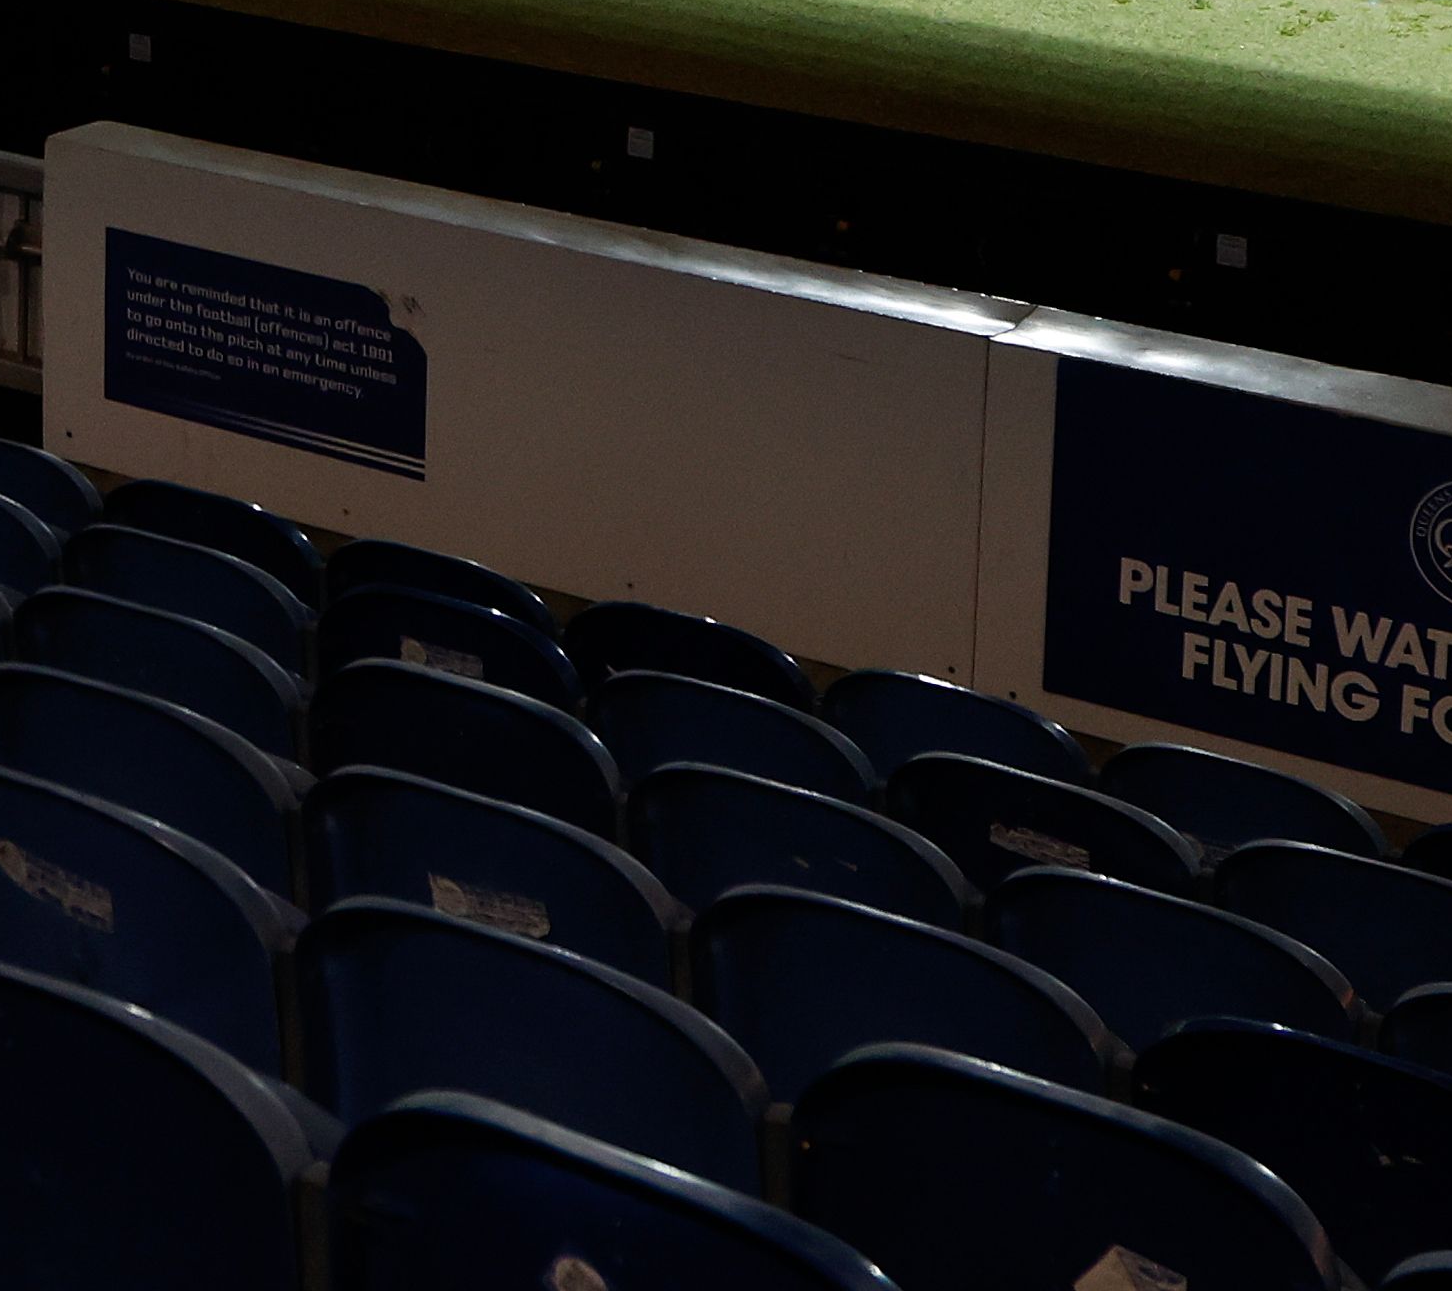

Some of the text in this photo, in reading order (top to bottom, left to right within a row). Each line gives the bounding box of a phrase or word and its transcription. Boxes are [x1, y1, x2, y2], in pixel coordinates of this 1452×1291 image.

[127, 266, 392, 342] You are reminded that it is an offence
[127, 290, 166, 308] under
[170, 298, 193, 315] the
[197, 302, 251, 329] football
[333, 337, 356, 355] act
[127, 308, 397, 385] to go onto the pitch at any time unless
[127, 328, 184, 353] directed
[188, 342, 203, 358] to
[207, 346, 224, 363] do
[228, 354, 244, 367] so
[247, 356, 259, 372] in
[263, 361, 279, 376] an
[283, 369, 364, 401] emergency.
[1117, 557, 1313, 648] PLEASE
[1181, 632, 1381, 723] FLYING
